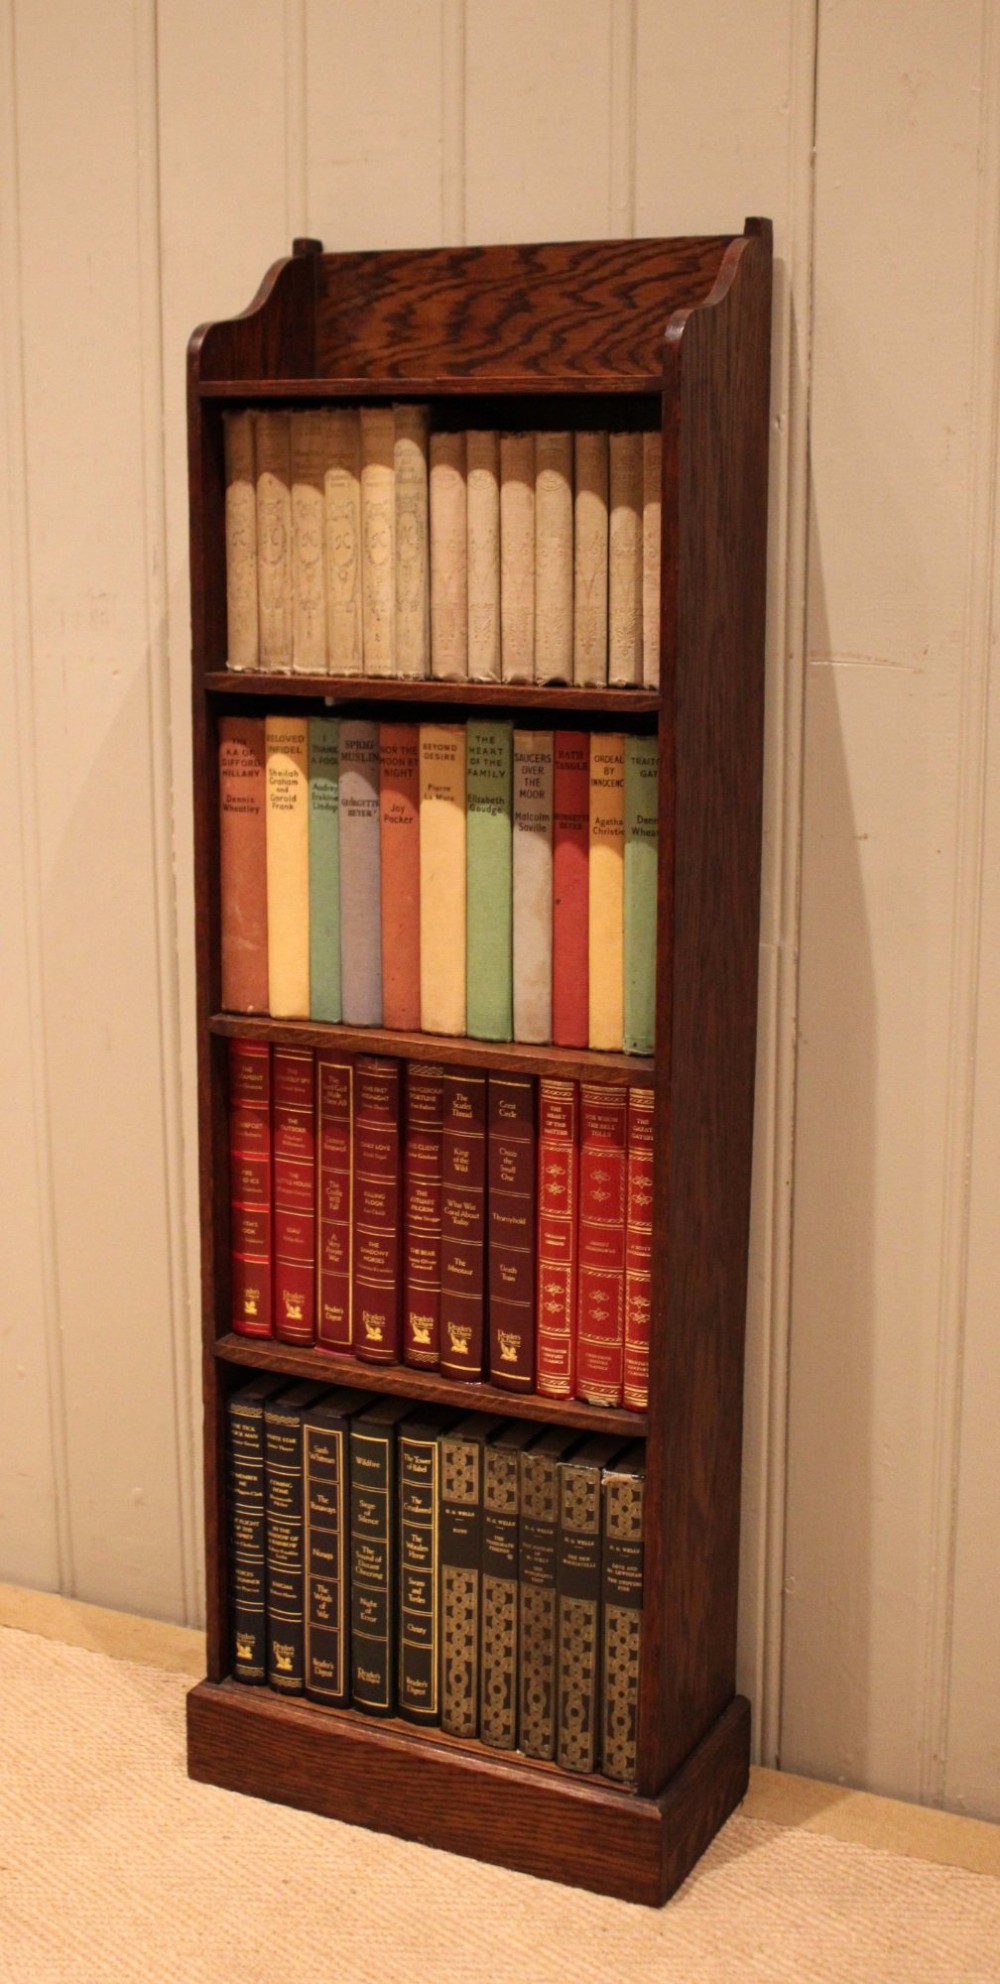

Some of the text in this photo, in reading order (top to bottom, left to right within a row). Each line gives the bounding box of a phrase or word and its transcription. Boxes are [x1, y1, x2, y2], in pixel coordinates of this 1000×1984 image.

[266, 734, 305, 743] BELOVED
[476, 735, 495, 744] THE
[267, 746, 303, 754] INFIDEL
[401, 746, 417, 755] THE
[423, 743, 457, 752] BEYOND
[469, 747, 503, 756] HEART
[424, 753, 456, 761] DESIRE
[470, 757, 502, 767] OF THE
[514, 752, 552, 764] SAUCERS
[594, 754, 624, 764] ORDEAL
[222, 769, 260, 778] HILLARY
[269, 768, 299, 778] Sheilah
[384, 768, 413, 778] NIGHT
[468, 769, 506, 779] FAMILY
[521, 765, 545, 775] OVER
[603, 766, 615, 776] BY
[269, 777, 299, 786] Graham
[525, 777, 540, 788] THE
[276, 786, 289, 794] and
[428, 783, 451, 792] Pierre
[226, 794, 255, 804] Dennis
[468, 793, 505, 805] Elizabeth
[519, 789, 545, 800] MOOR
[223, 804, 260, 815] Wheatley
[272, 803, 295, 811] Frank
[391, 803, 406, 814] Joy
[469, 804, 502, 816] Goudge
[384, 814, 414, 824] Packer
[515, 811, 550, 822] Malcolm
[518, 822, 547, 833] Saville
[595, 816, 624, 829] Agatha
[456, 1093, 468, 1102] The
[453, 1147, 469, 1158] King
[503, 1157, 513, 1165] the
[455, 1257, 466, 1267] The
[355, 1456, 380, 1468] Wildfire
[317, 1494, 329, 1504] The
[411, 1495, 422, 1505] The
[364, 1508, 371, 1516] of
[537, 1527, 554, 1535] WELLS
[411, 1533, 423, 1543] The
[362, 1545, 375, 1555] The
[374, 1555, 382, 1563] of
[316, 1584, 329, 1594] The
[316, 1609, 329, 1619] War
